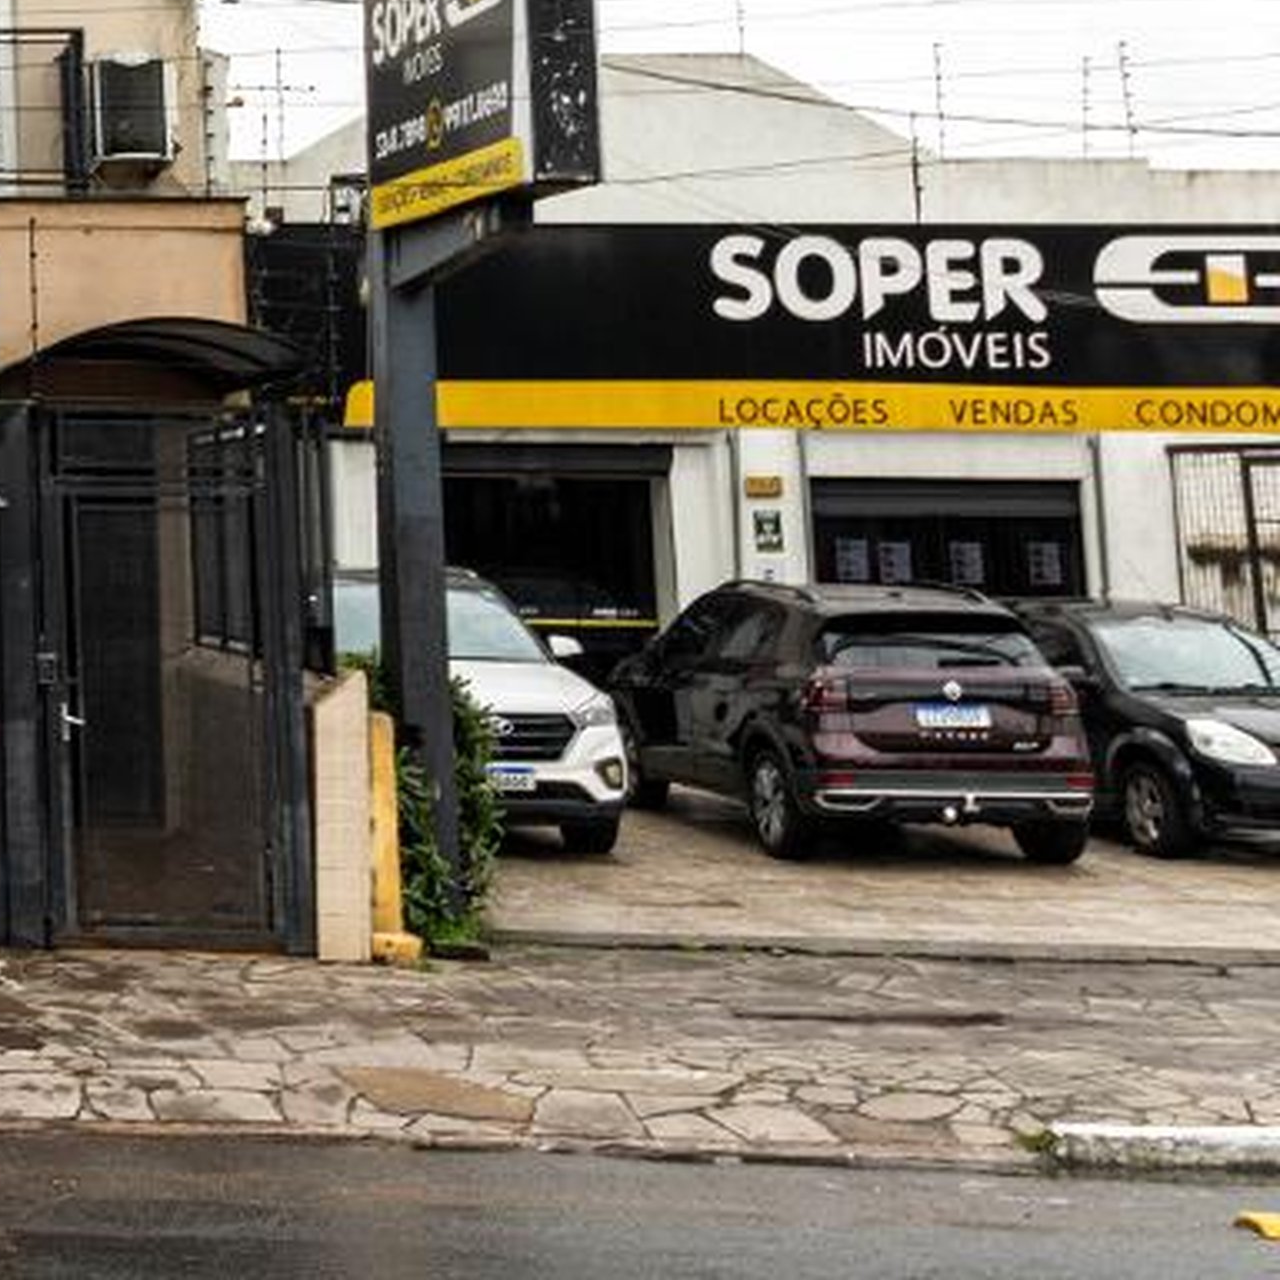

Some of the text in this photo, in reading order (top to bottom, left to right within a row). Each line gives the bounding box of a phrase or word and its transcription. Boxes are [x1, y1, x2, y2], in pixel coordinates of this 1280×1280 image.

[709, 235, 1048, 321] SOPER
[864, 327, 1051, 369] IMÓVEIS
[718, 393, 889, 429] LOCAÇÕES
[949, 399, 1079, 426] VENDAS
